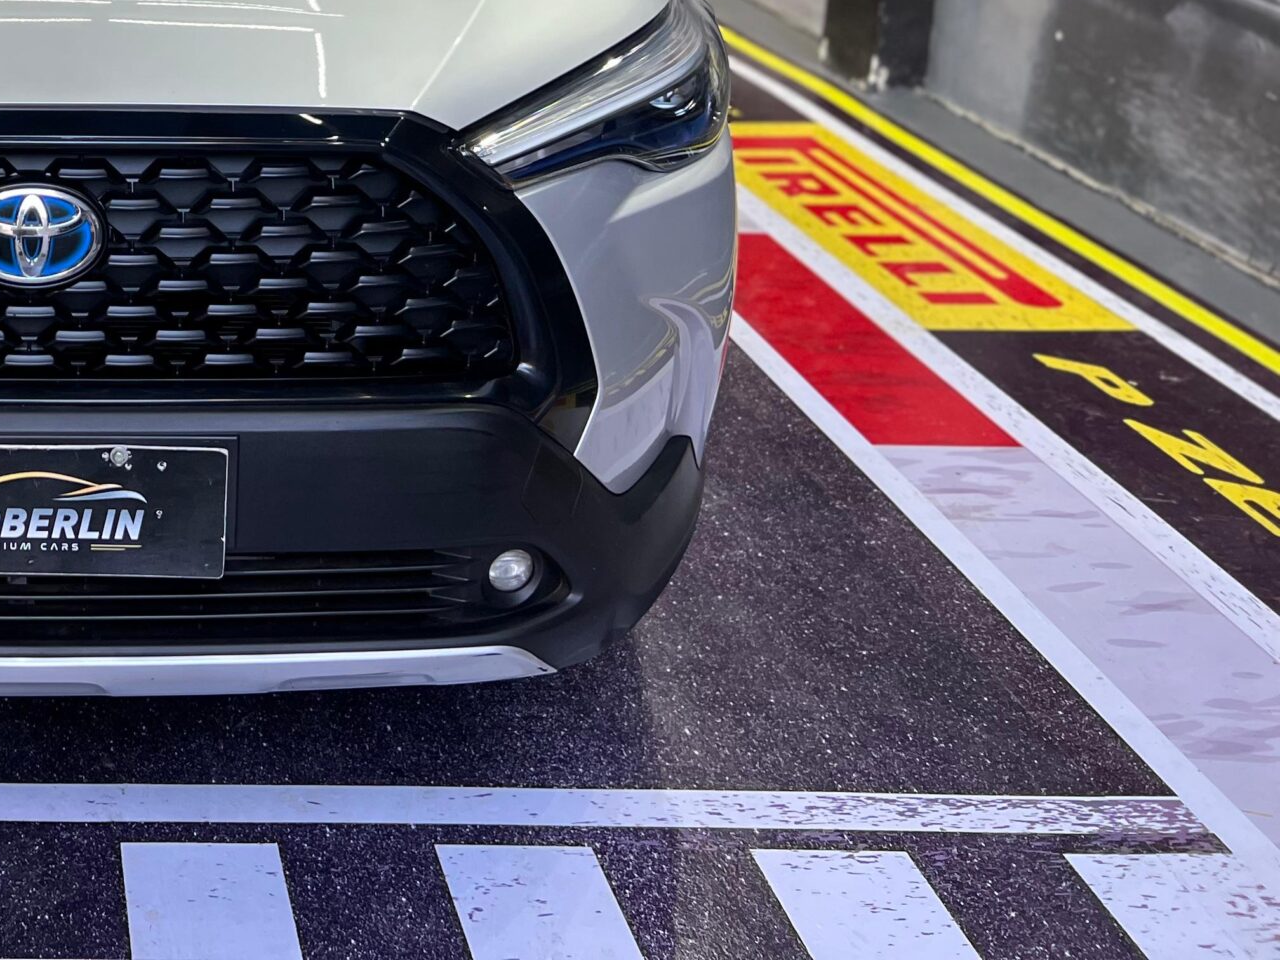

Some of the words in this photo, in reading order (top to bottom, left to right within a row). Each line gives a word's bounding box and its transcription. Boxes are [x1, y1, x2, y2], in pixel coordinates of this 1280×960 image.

[731, 136, 1063, 308] PIRELLI
[1032, 353, 1155, 406] P
[40, 542, 80, 552] CARS
